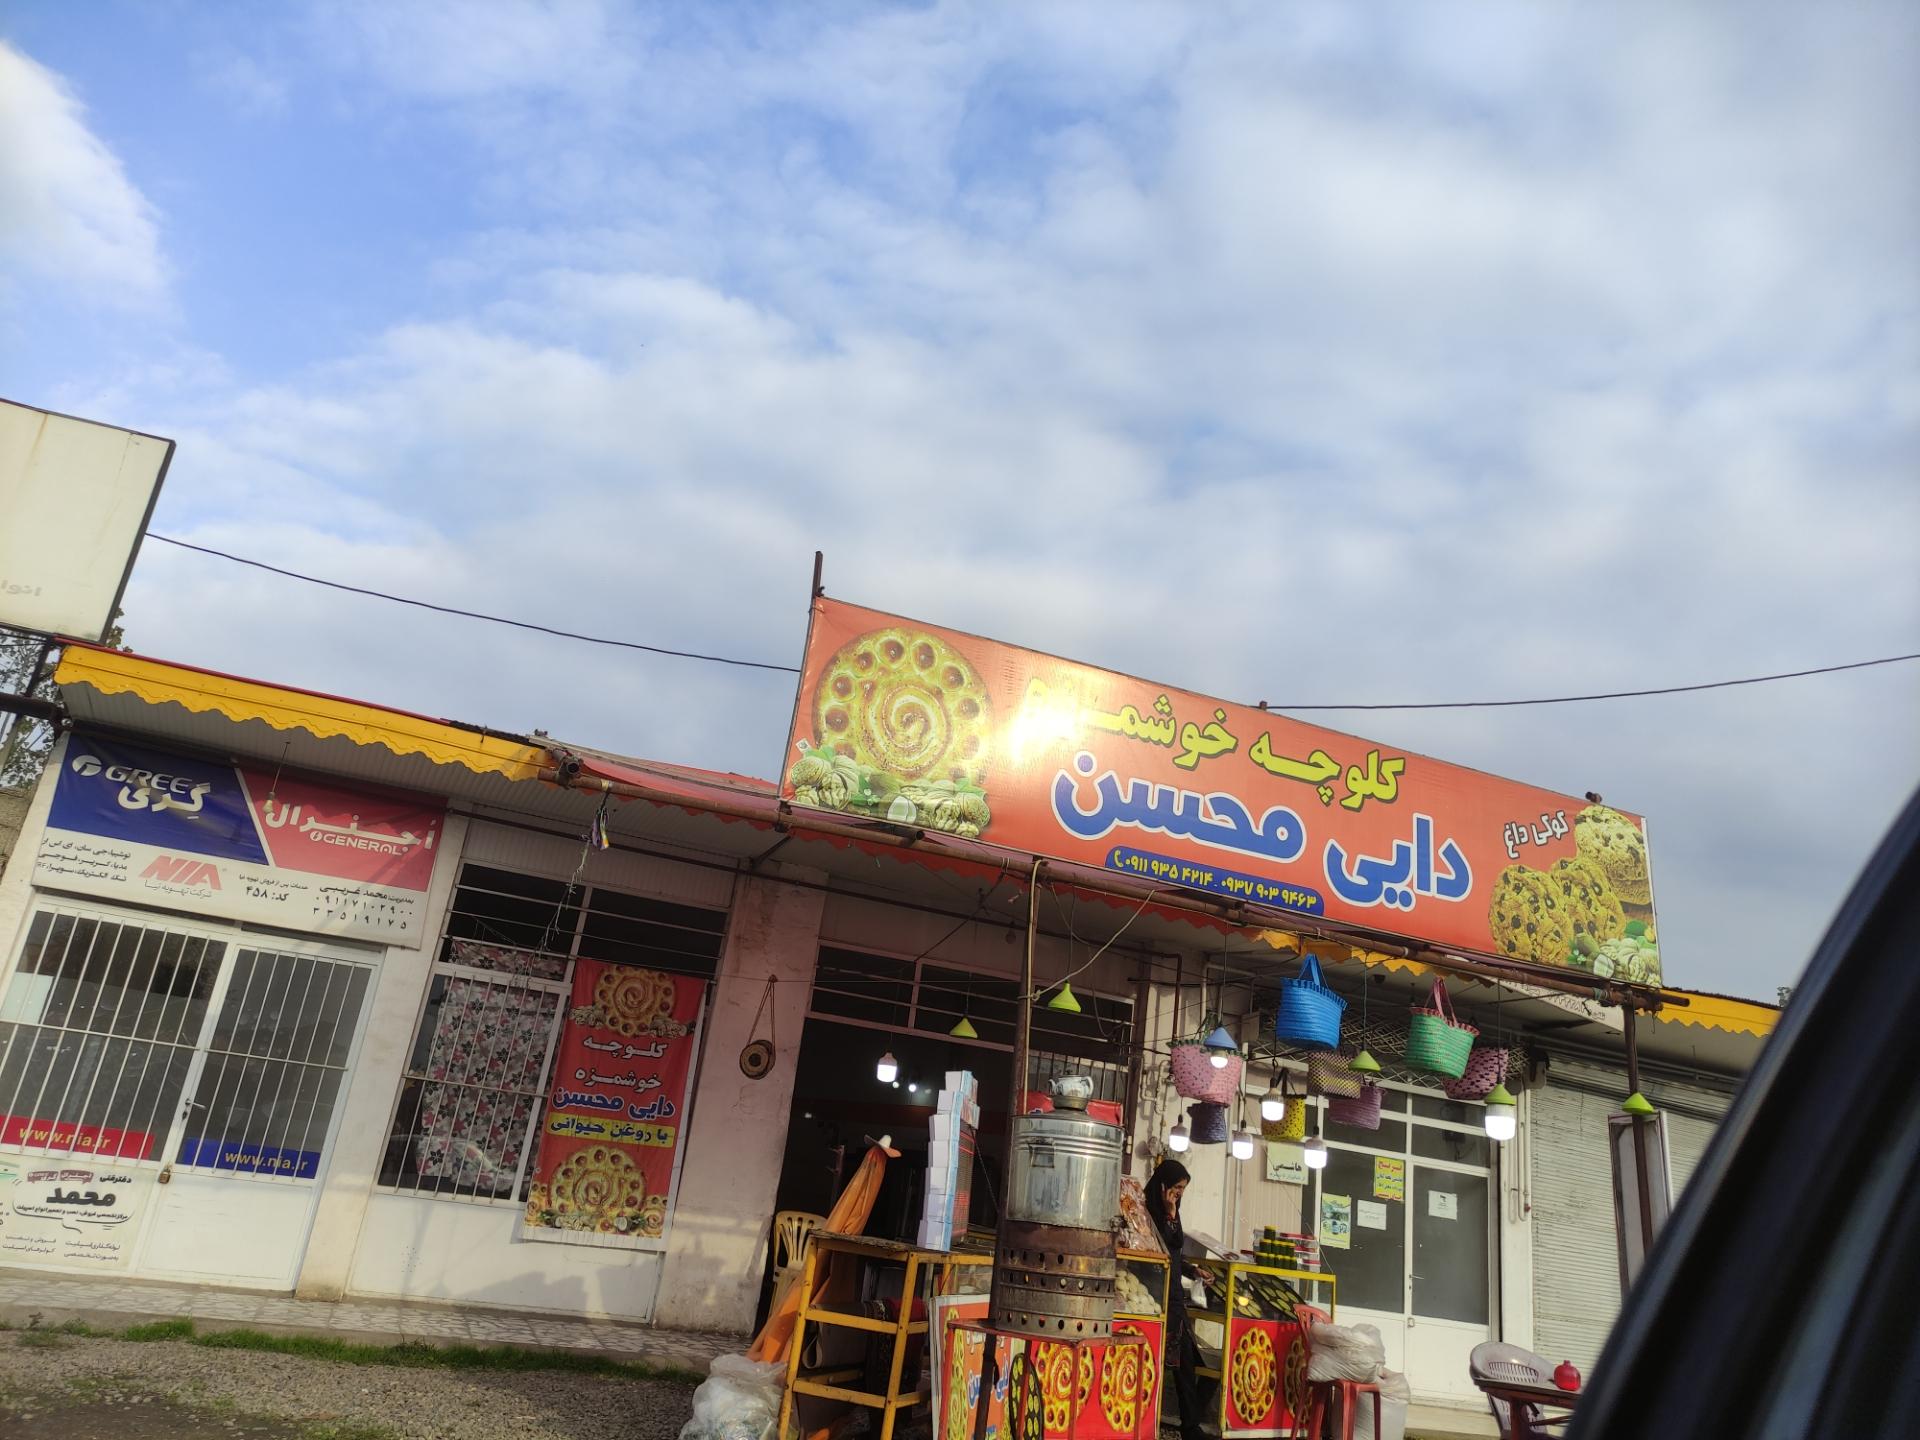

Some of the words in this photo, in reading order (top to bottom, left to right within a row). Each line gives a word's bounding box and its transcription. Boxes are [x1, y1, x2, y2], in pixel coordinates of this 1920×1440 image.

[105, 765, 193, 794] GREE
[1249, 731, 1405, 812] کلوچه
[1051, 750, 1308, 863] محسن
[1503, 822, 1529, 859] داغ
[1530, 810, 1569, 847] کوکی
[323, 833, 403, 856] GENERAL
[139, 855, 223, 891] NIA
[1323, 813, 1473, 911] دایی
[1125, 854, 1148, 873] ۰۹۱۱
[1151, 859, 1178, 879] ۹۳۵
[1221, 876, 1253, 894] ۰۹۳۷
[1256, 883, 1279, 901] ۹۰۳
[246, 885, 269, 900] ۴۵۸
[363, 889, 388, 900] محمد
[583, 1036, 668, 1059] کلوچه
[575, 1067, 662, 1092] خوشمزه
[552, 1087, 624, 1111] محسن
[628, 1095, 675, 1120] دایی
[551, 1117, 605, 1135] حیوانی
[610, 1123, 651, 1141] روغن
[657, 1128, 669, 1144] با
[225, 1151, 308, 1171] www.nia.r
[46, 1187, 116, 1207] محمد
